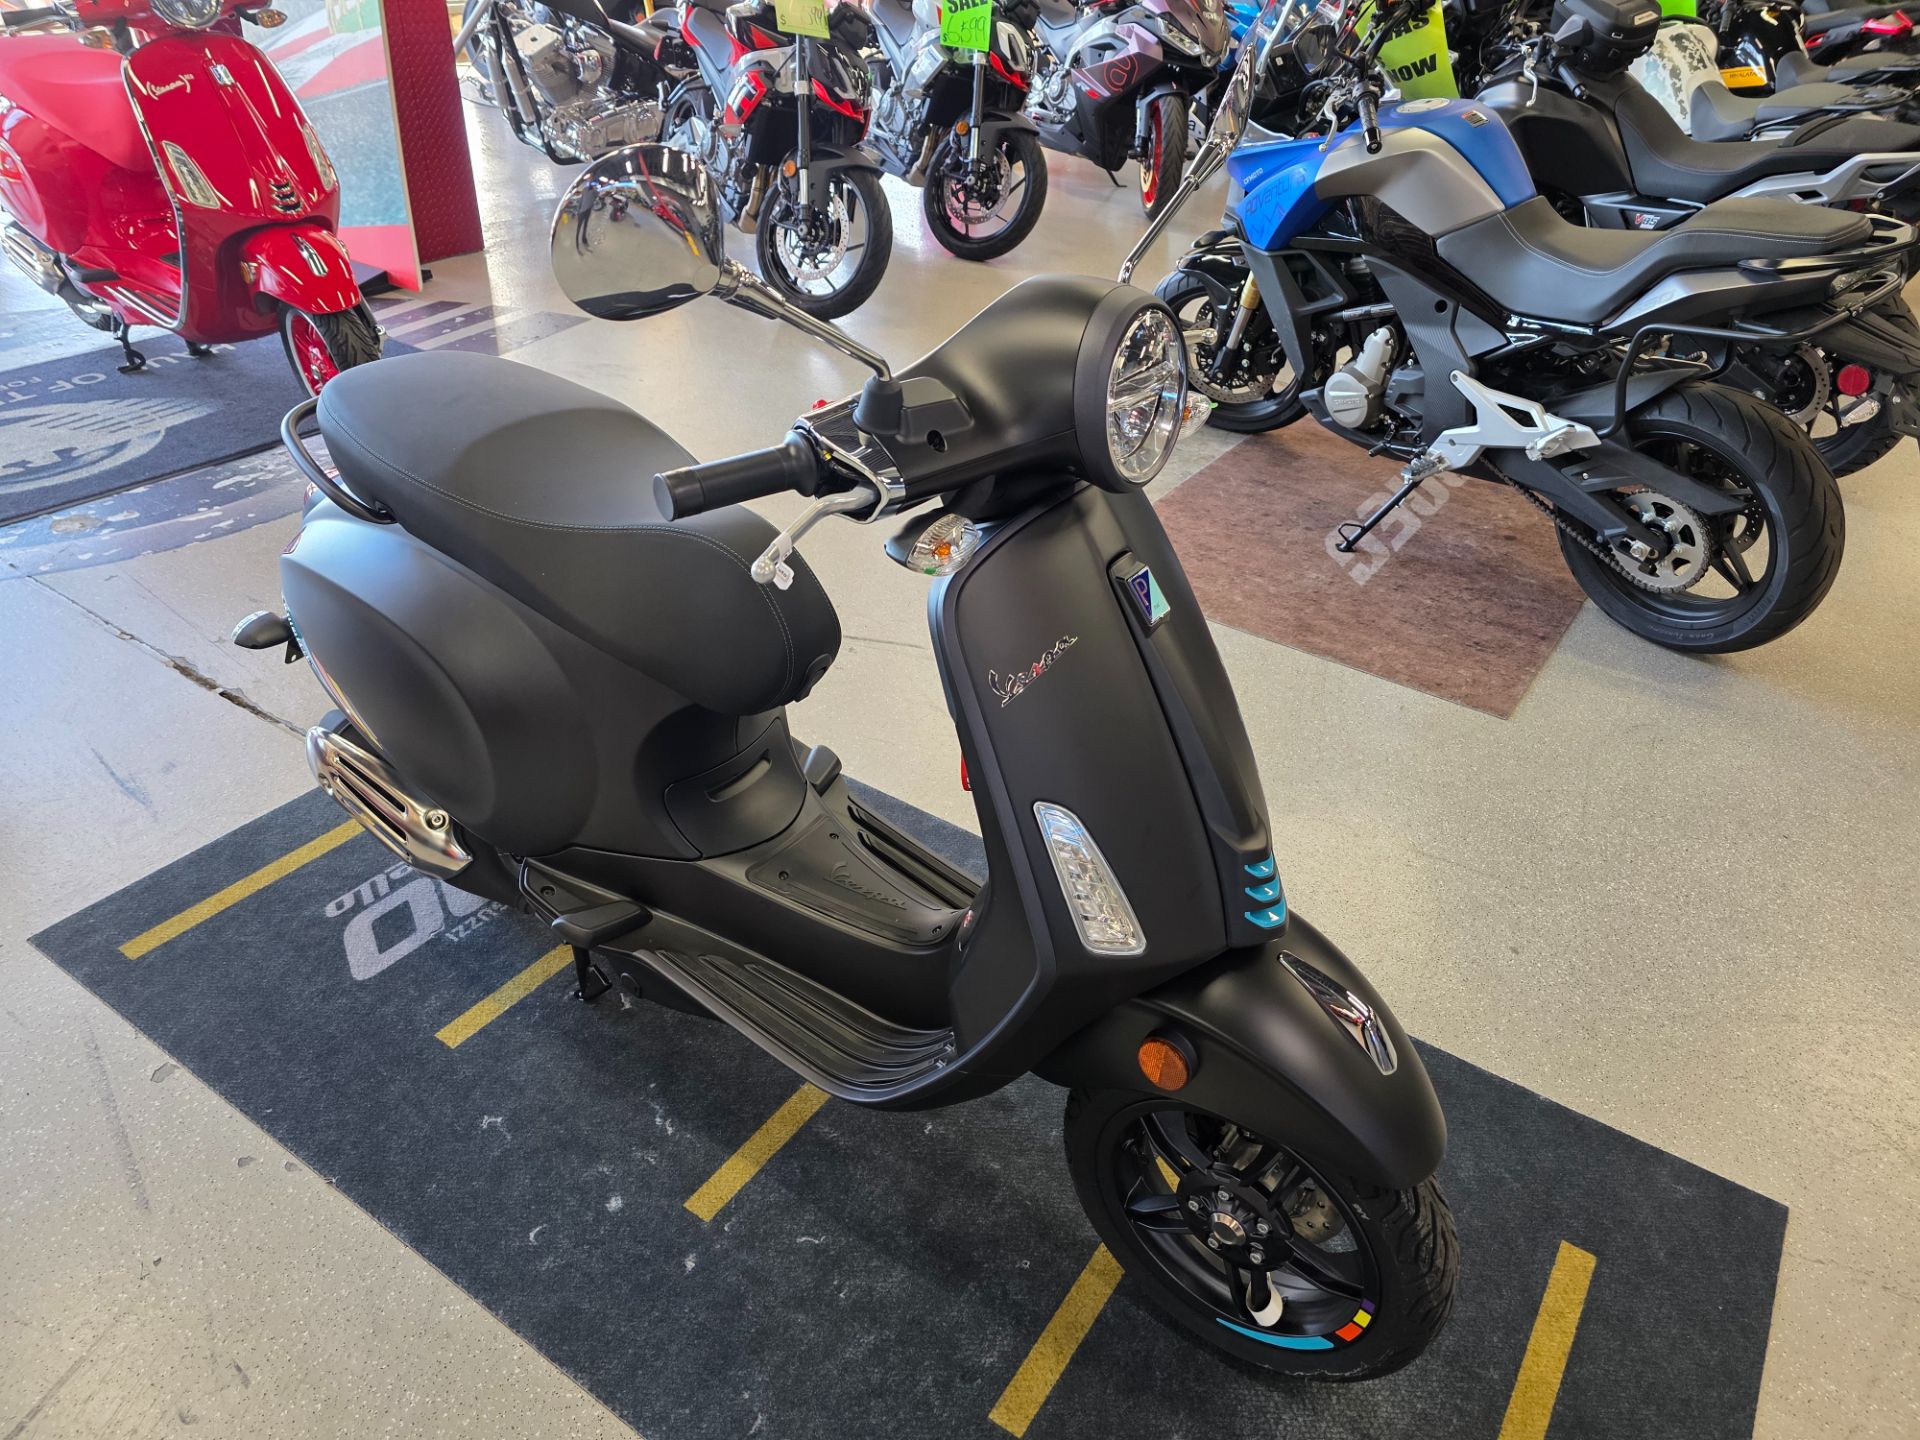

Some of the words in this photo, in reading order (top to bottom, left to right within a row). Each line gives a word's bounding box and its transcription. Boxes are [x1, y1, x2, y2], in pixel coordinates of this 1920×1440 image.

[1386, 53, 1437, 83] NOW
[1729, 71, 1760, 79] HIMALAYA
[48, 373, 107, 393] OF
[988, 635, 1078, 708] Vespa
